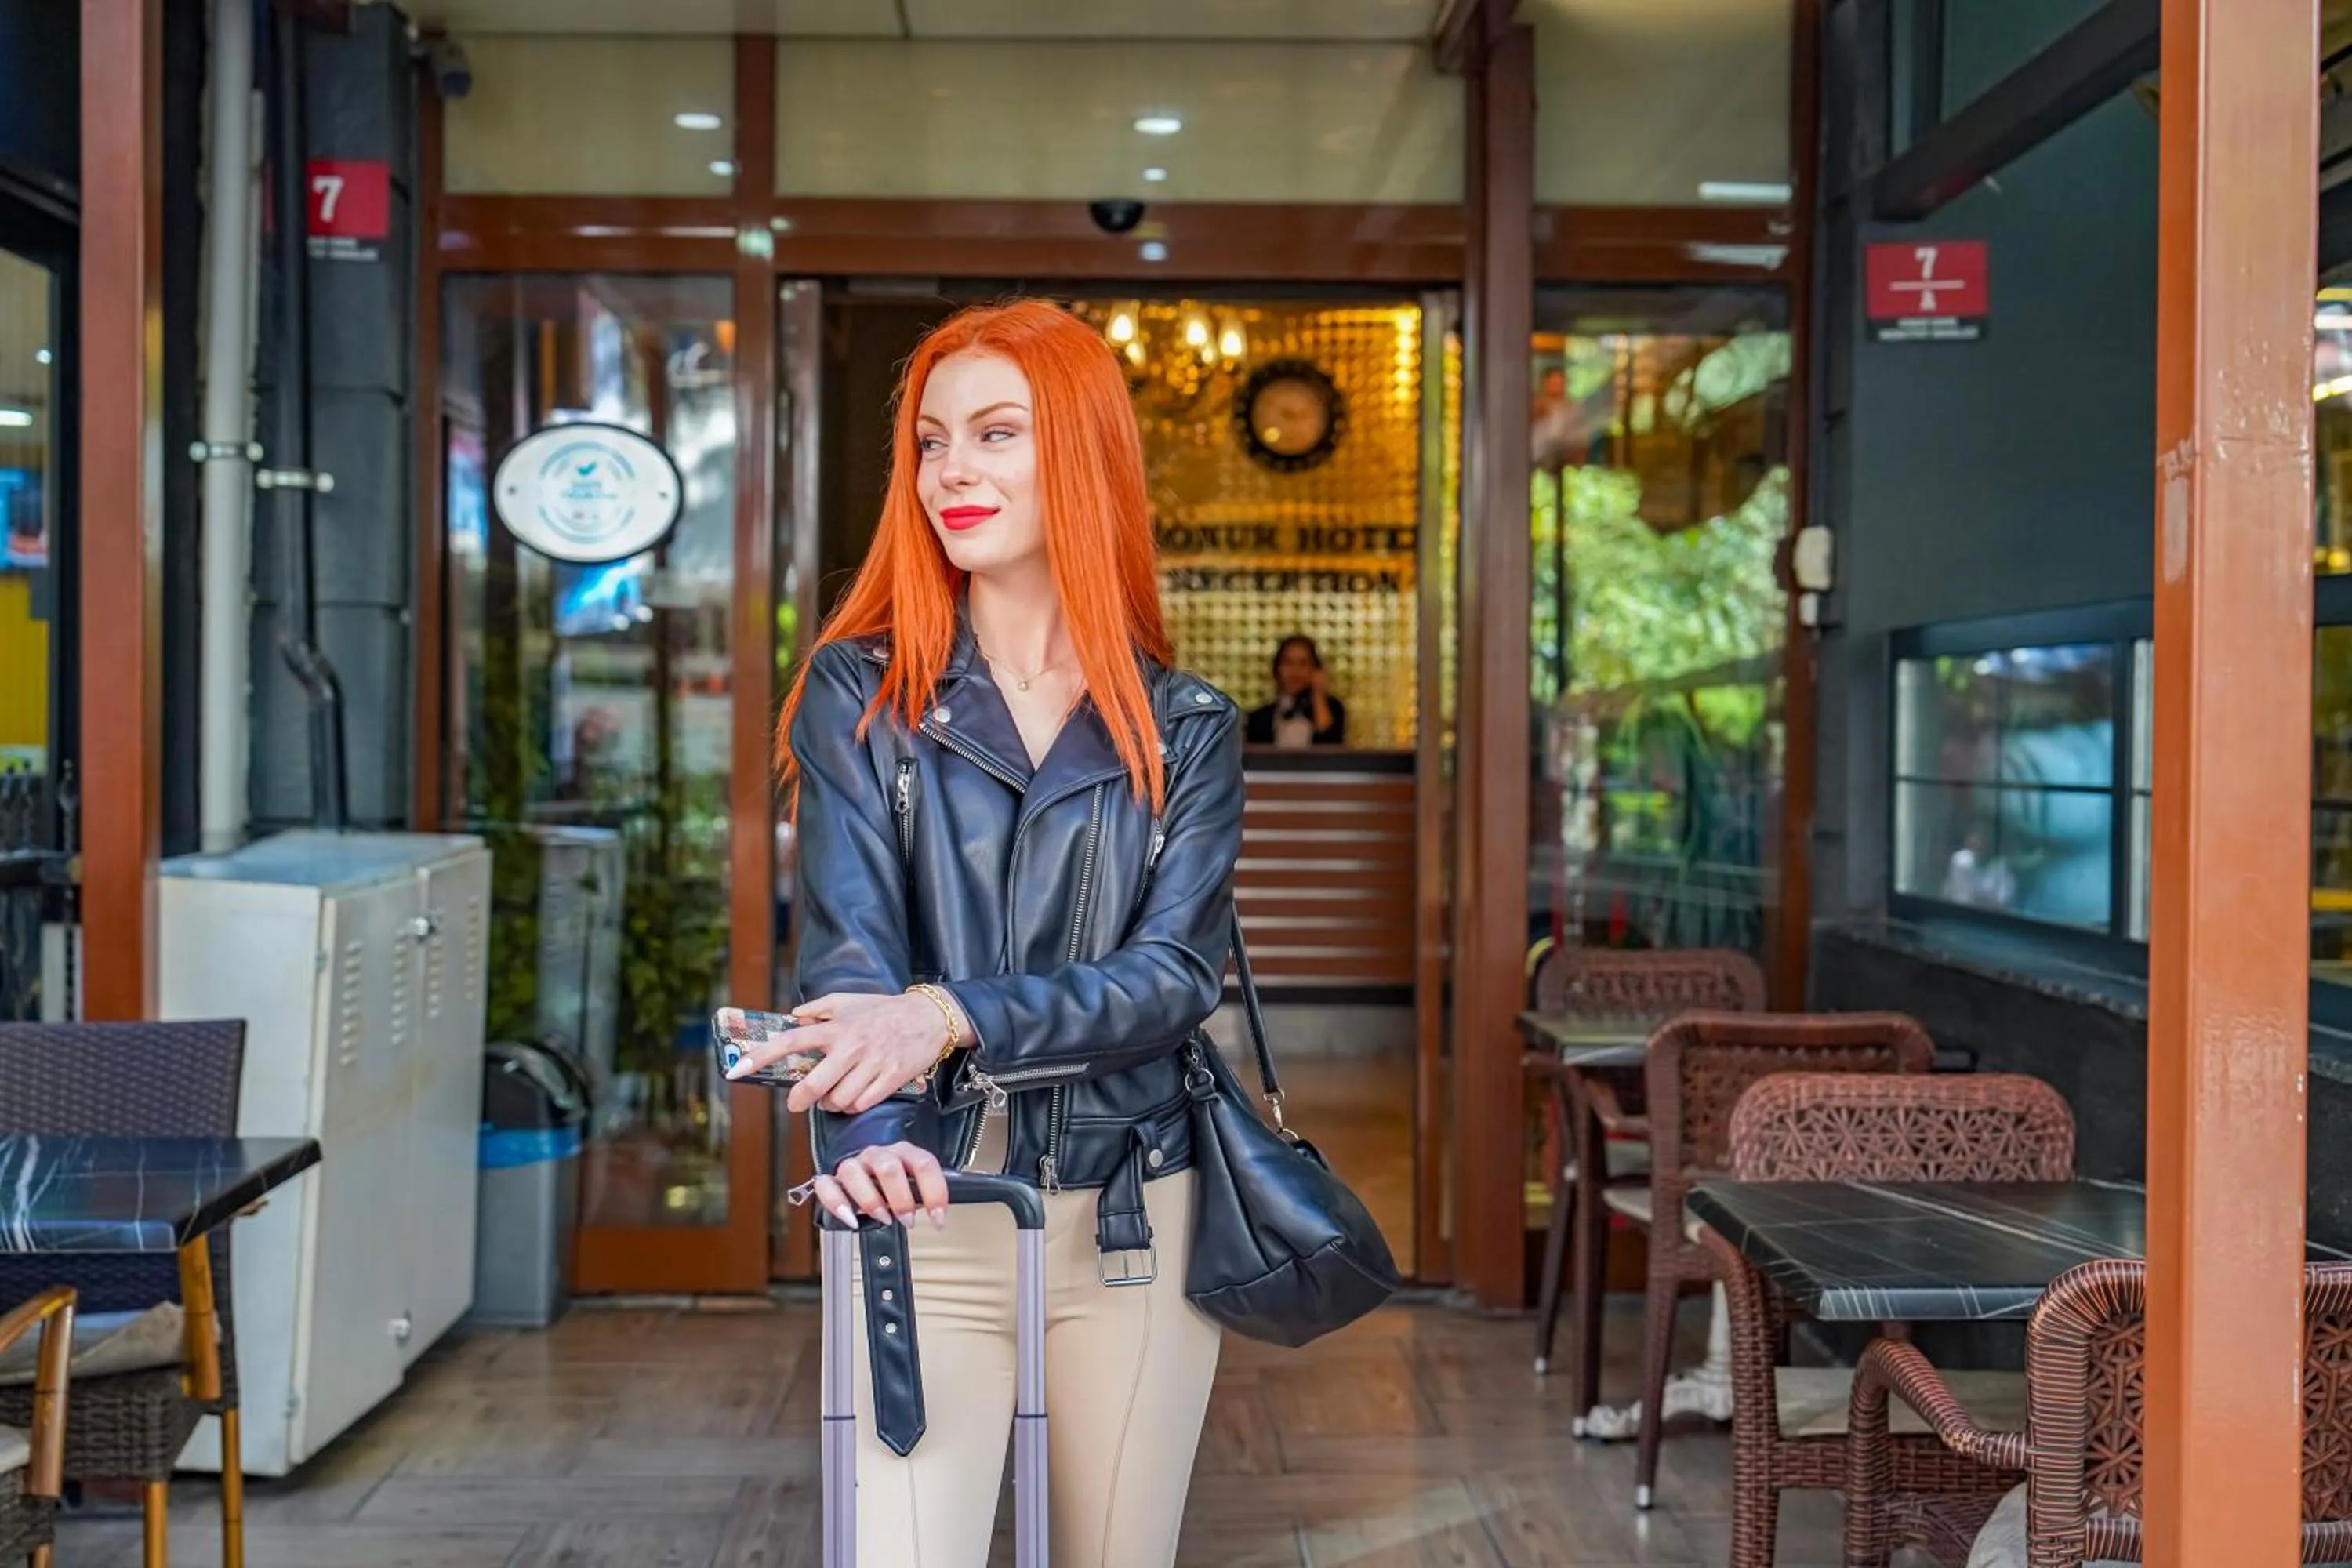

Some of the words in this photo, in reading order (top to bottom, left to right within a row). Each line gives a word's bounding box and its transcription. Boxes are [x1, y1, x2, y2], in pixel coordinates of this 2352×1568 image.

[313, 175, 344, 223] 7
[1915, 246, 1938, 279] 7
[1295, 524, 1418, 553] HOTE
